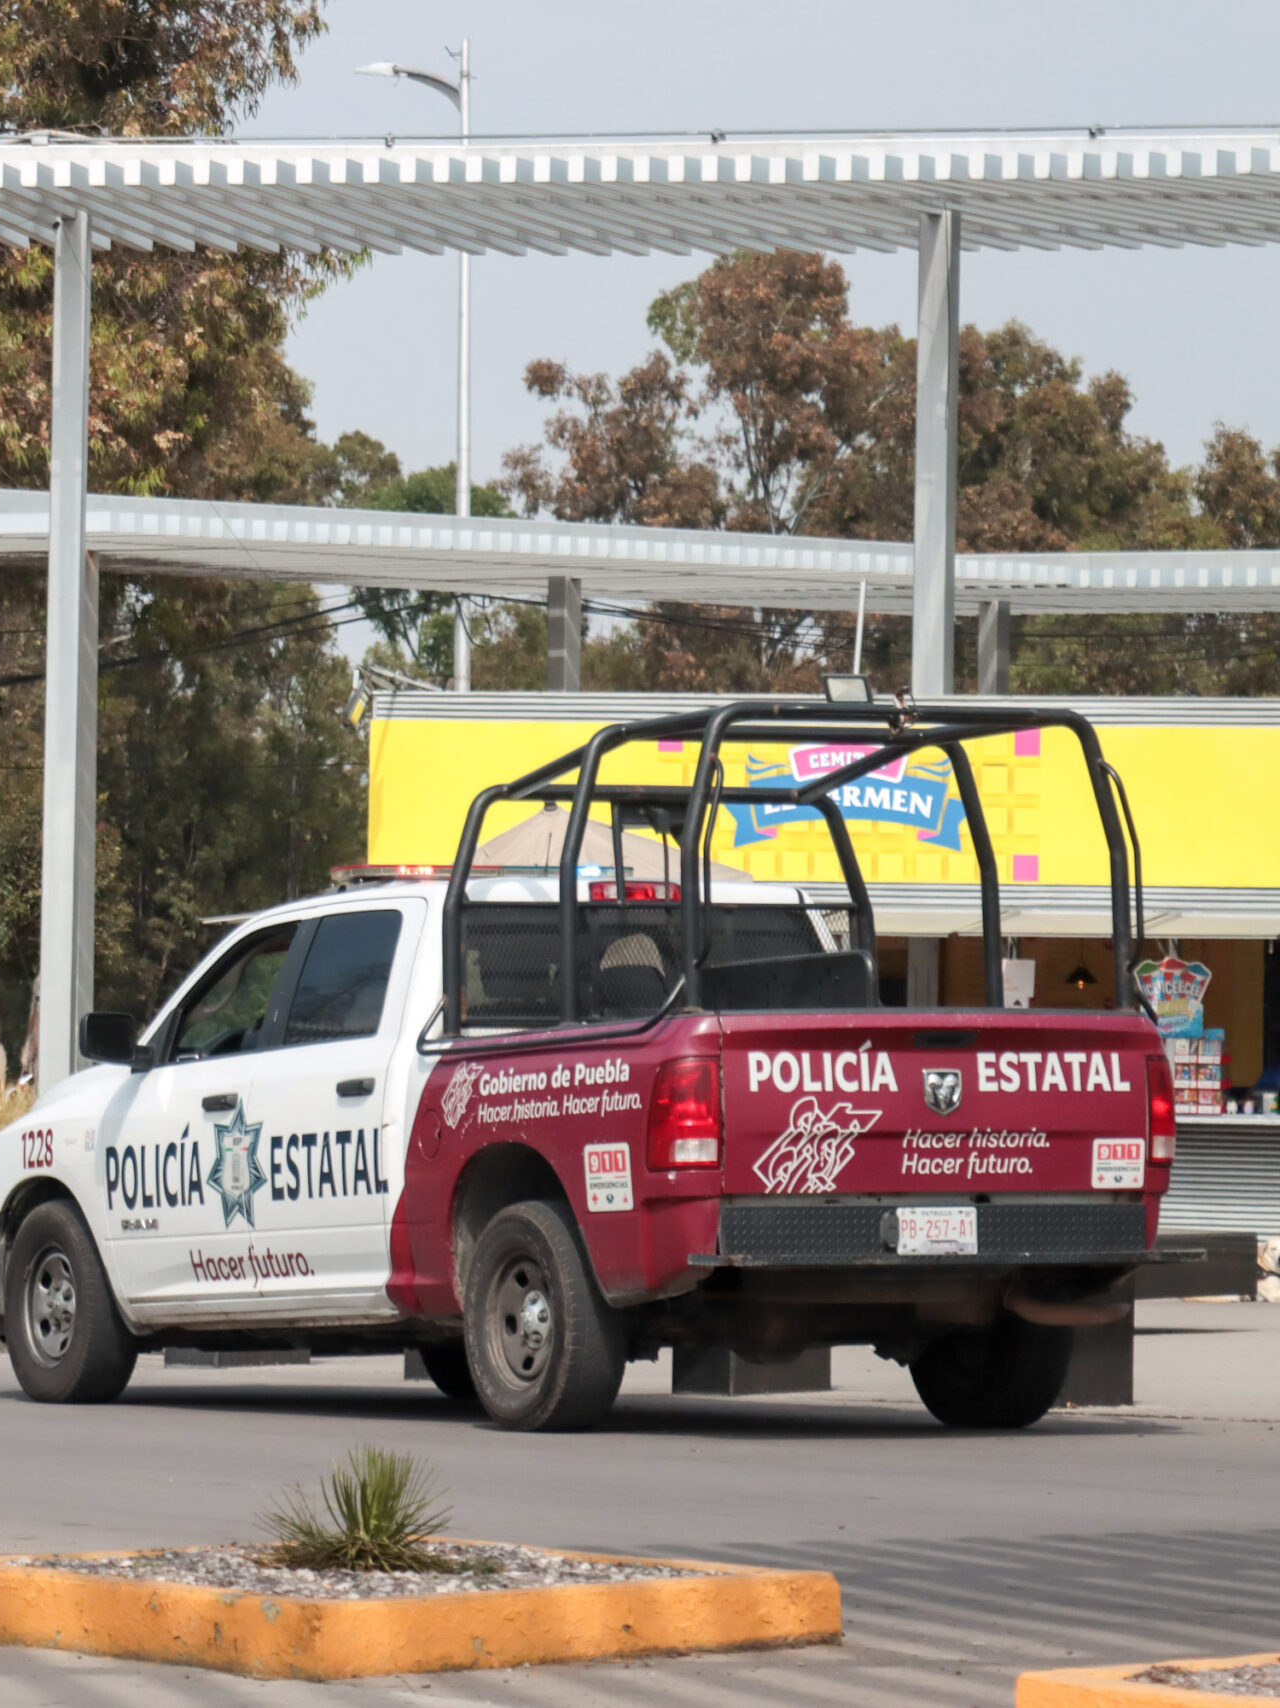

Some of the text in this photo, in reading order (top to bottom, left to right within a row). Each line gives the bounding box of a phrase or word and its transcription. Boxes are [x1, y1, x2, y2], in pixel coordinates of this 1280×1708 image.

[809, 751, 888, 770] CEMIT
[825, 784, 934, 818] ARMEN
[479, 1058, 630, 1096] Gobierno de Puebla
[748, 1039, 1131, 1093] POLICÍA ESTATAL
[478, 1090, 642, 1123] Hacer historia. Hacer futuro.
[21, 1128, 54, 1169] 1228
[902, 1127, 1051, 1149] Hacer historia.
[1099, 1144, 1139, 1160] 911
[105, 1122, 390, 1211] POLICÍA ESTATAL
[589, 1151, 626, 1173] 911
[901, 1153, 1033, 1179] Hacer futuro.
[901, 1219, 974, 1239] PB-257-A1
[189, 1246, 315, 1288] Hacer futuro.
